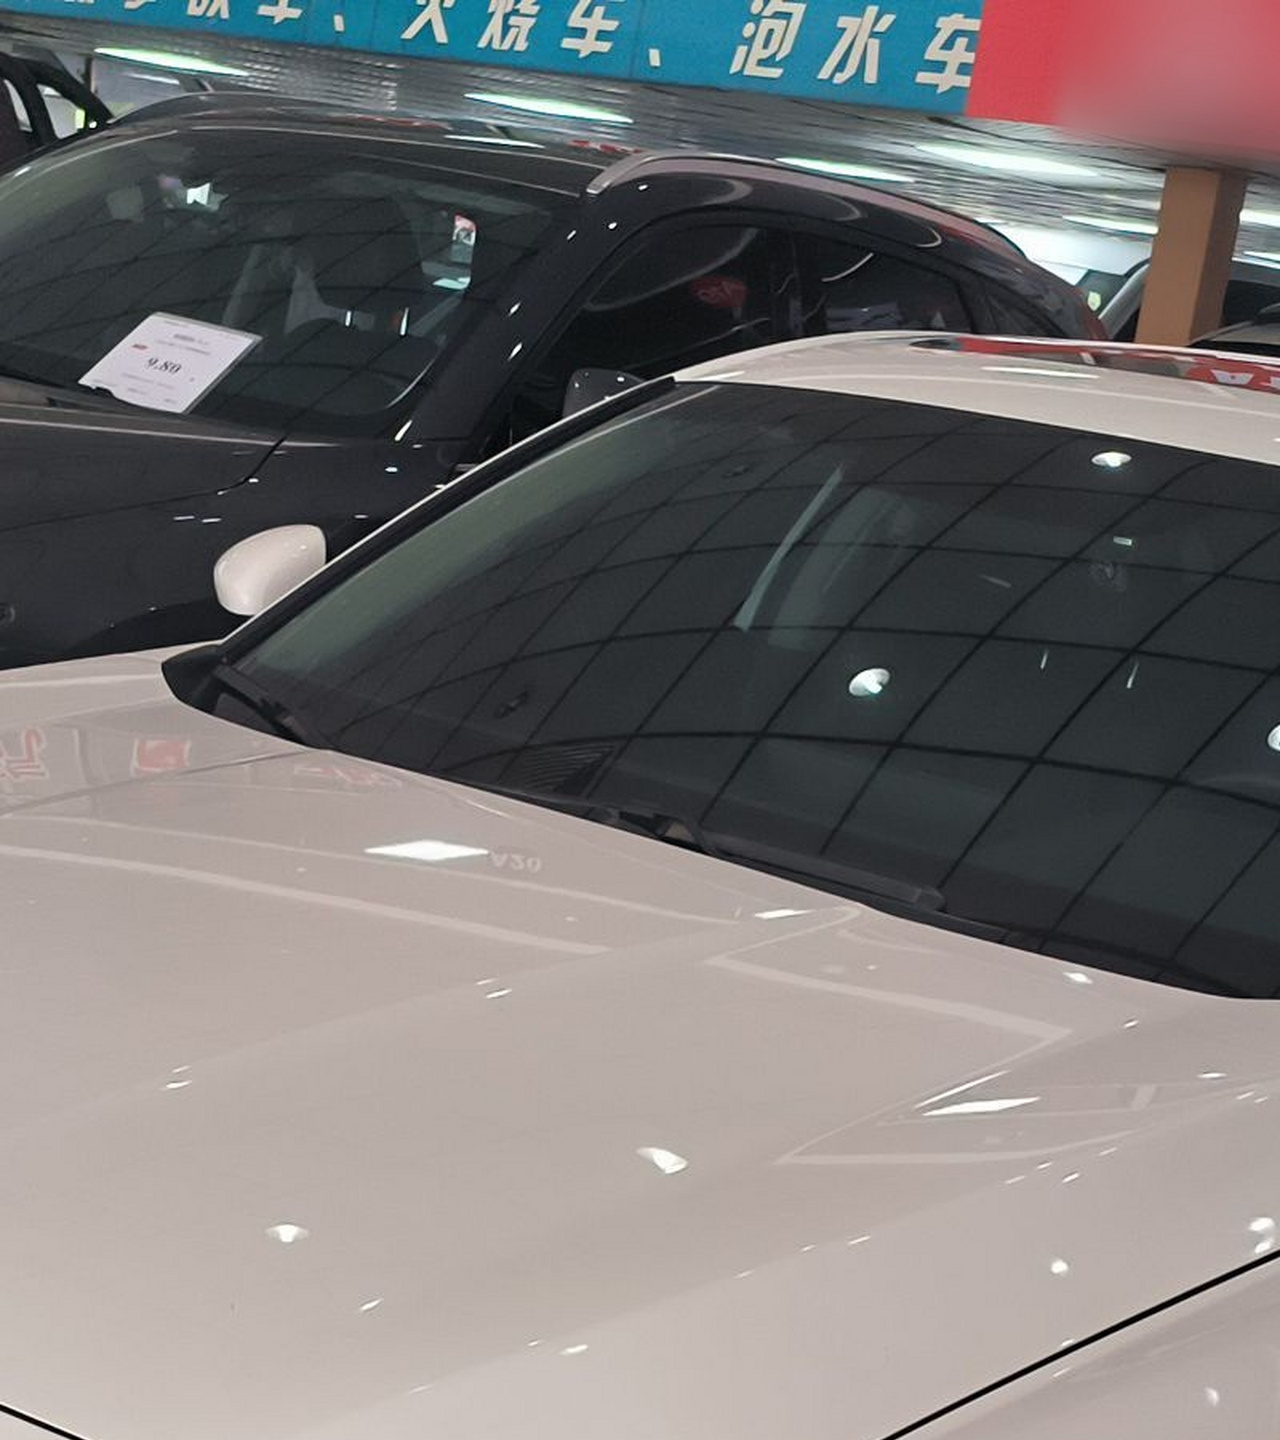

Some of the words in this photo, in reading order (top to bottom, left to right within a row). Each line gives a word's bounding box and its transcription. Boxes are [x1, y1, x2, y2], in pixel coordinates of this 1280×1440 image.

[63, 0, 977, 94] 、火烧车、泡水车
